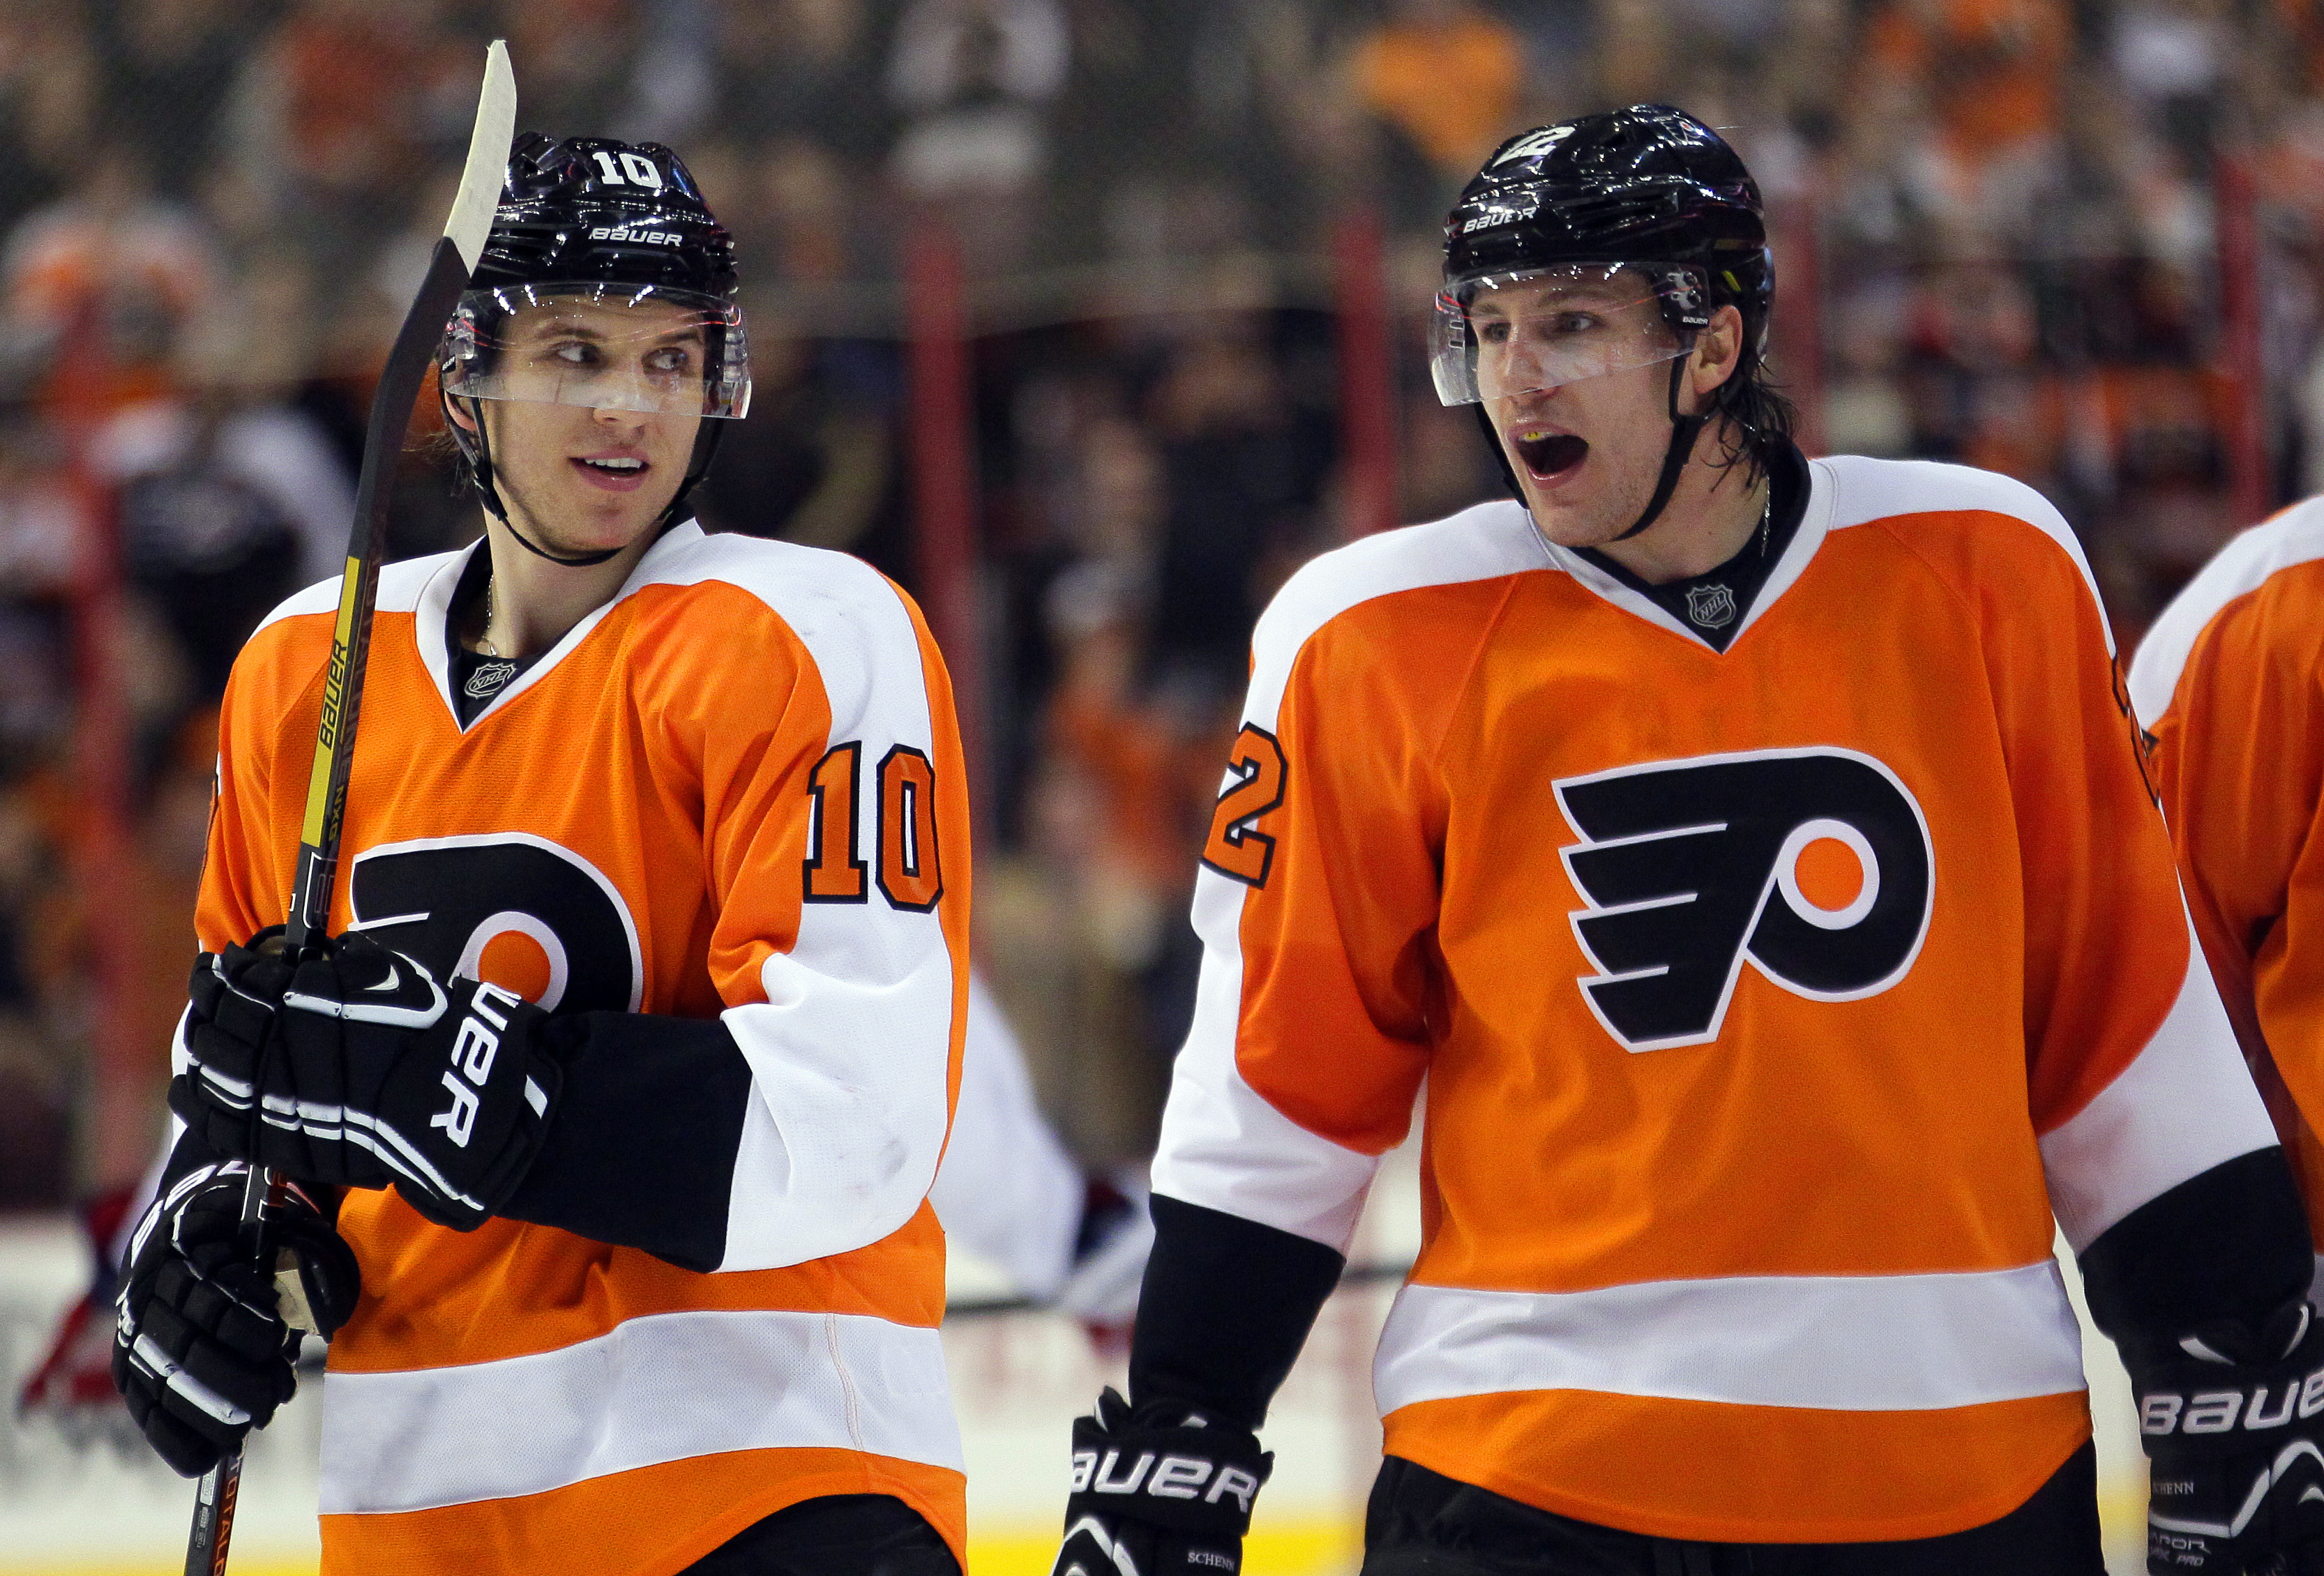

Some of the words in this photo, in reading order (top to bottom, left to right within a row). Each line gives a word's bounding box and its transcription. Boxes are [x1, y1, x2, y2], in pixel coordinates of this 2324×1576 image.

[592, 151, 662, 188] 10
[589, 227, 683, 248] BAUER
[1699, 596, 1725, 620] NHL
[472, 669, 505, 690] NHL
[319, 639, 349, 750] BAUER
[803, 740, 944, 914] 10
[1187, 1550, 1236, 1573] SCHENN
